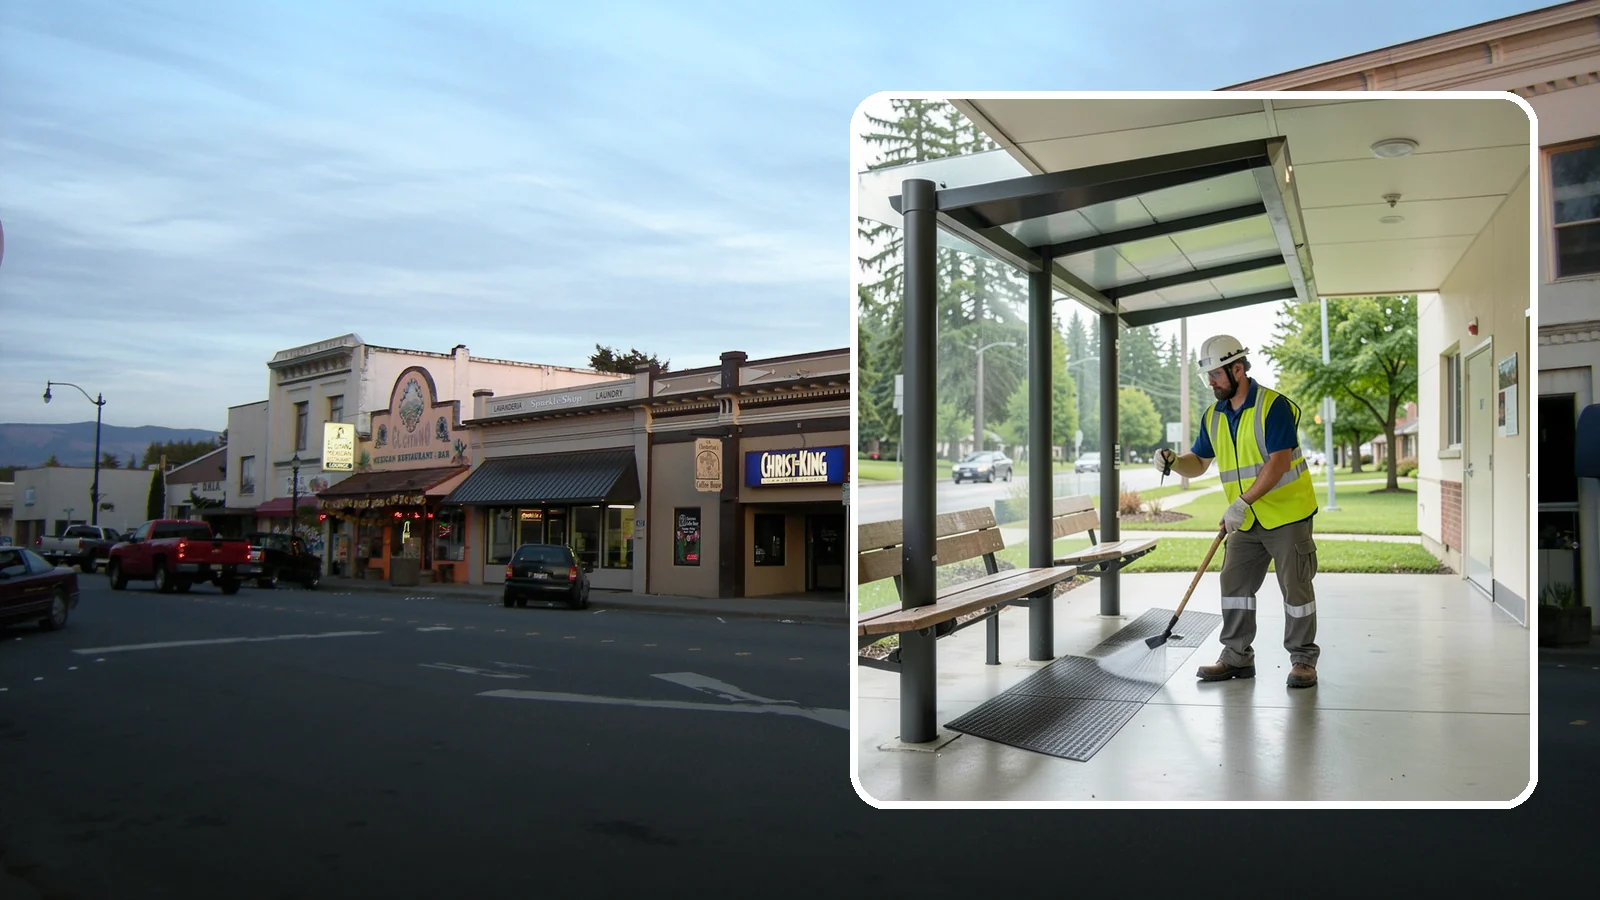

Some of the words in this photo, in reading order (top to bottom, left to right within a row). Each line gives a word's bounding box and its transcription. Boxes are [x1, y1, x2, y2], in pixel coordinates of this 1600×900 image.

[493, 402, 522, 412] LAVANDERIA
[530, 397, 560, 408] Sparkle
[561, 394, 583, 404] Shop
[595, 389, 623, 400] LAUNDRY
[373, 455, 396, 464] MEXICAN
[398, 452, 433, 462] RESTAURANT
[438, 450, 450, 459] BAR
[760, 452, 797, 478] CHRIST
[798, 450, 827, 477] KING
